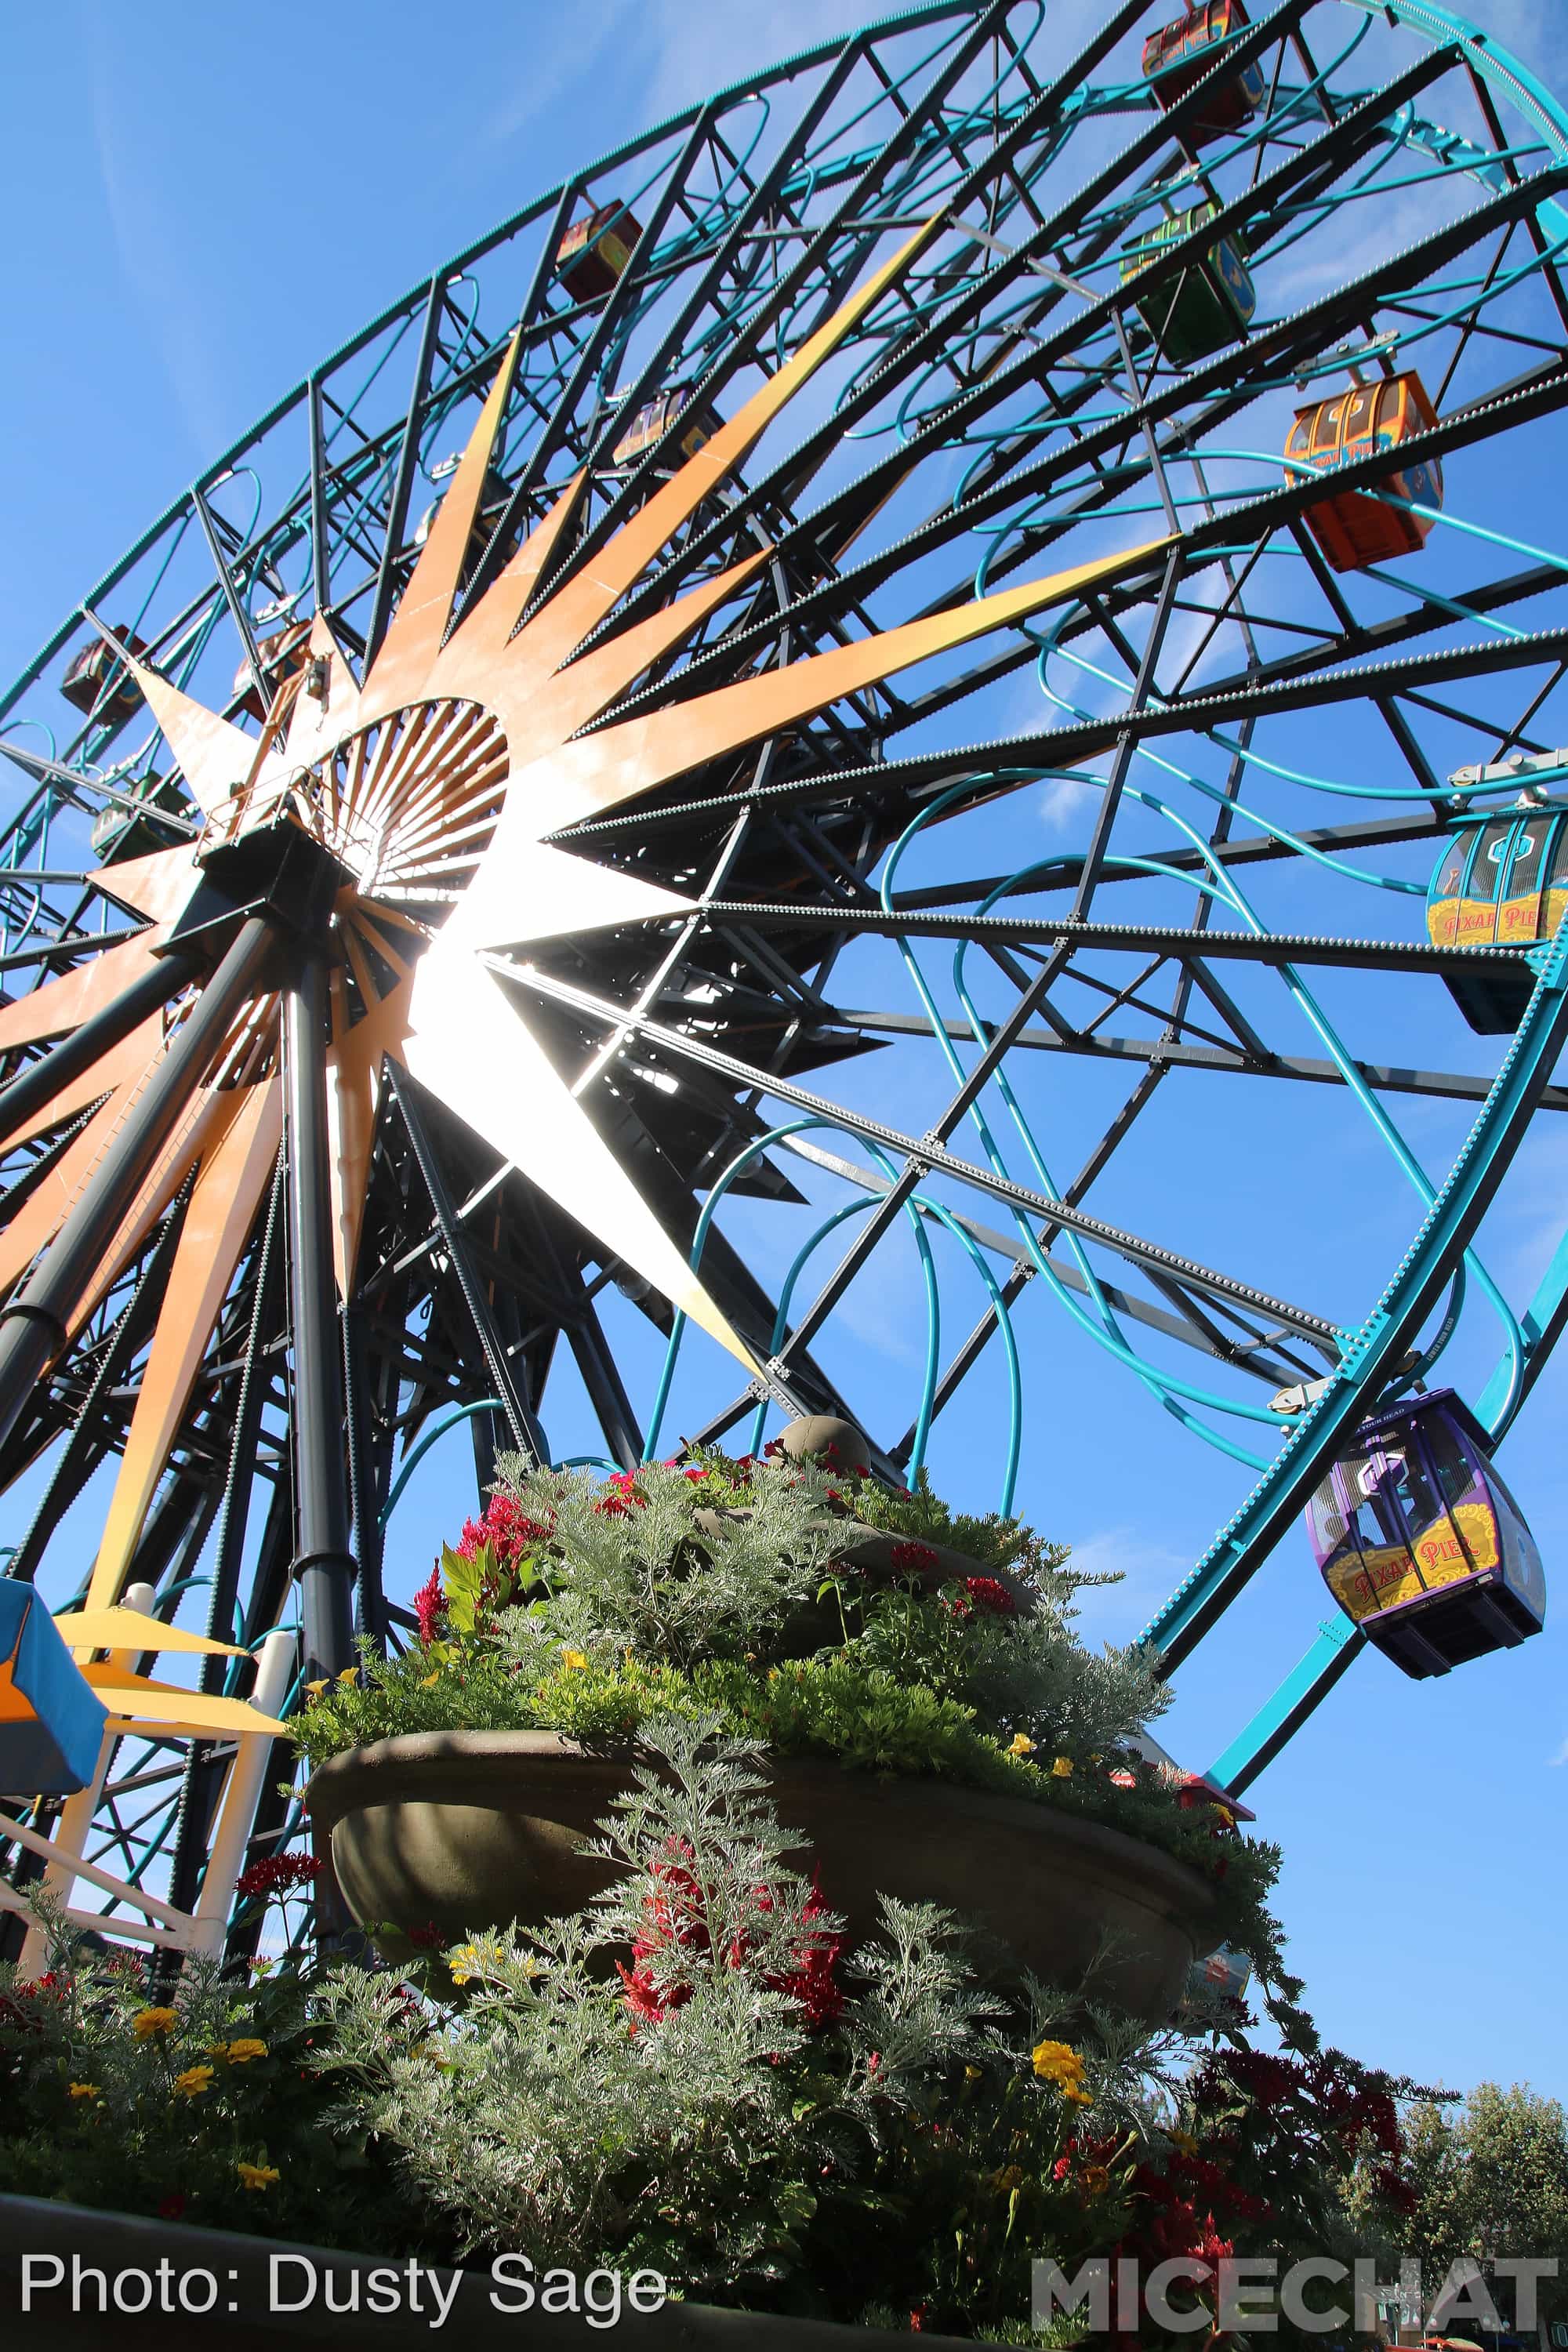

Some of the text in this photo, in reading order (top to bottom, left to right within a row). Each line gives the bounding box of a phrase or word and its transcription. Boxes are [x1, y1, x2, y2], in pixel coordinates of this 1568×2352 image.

[1361, 1408, 1405, 1430] YOUR HEAD
[1355, 1536, 1480, 1604] PIXAR PIER
